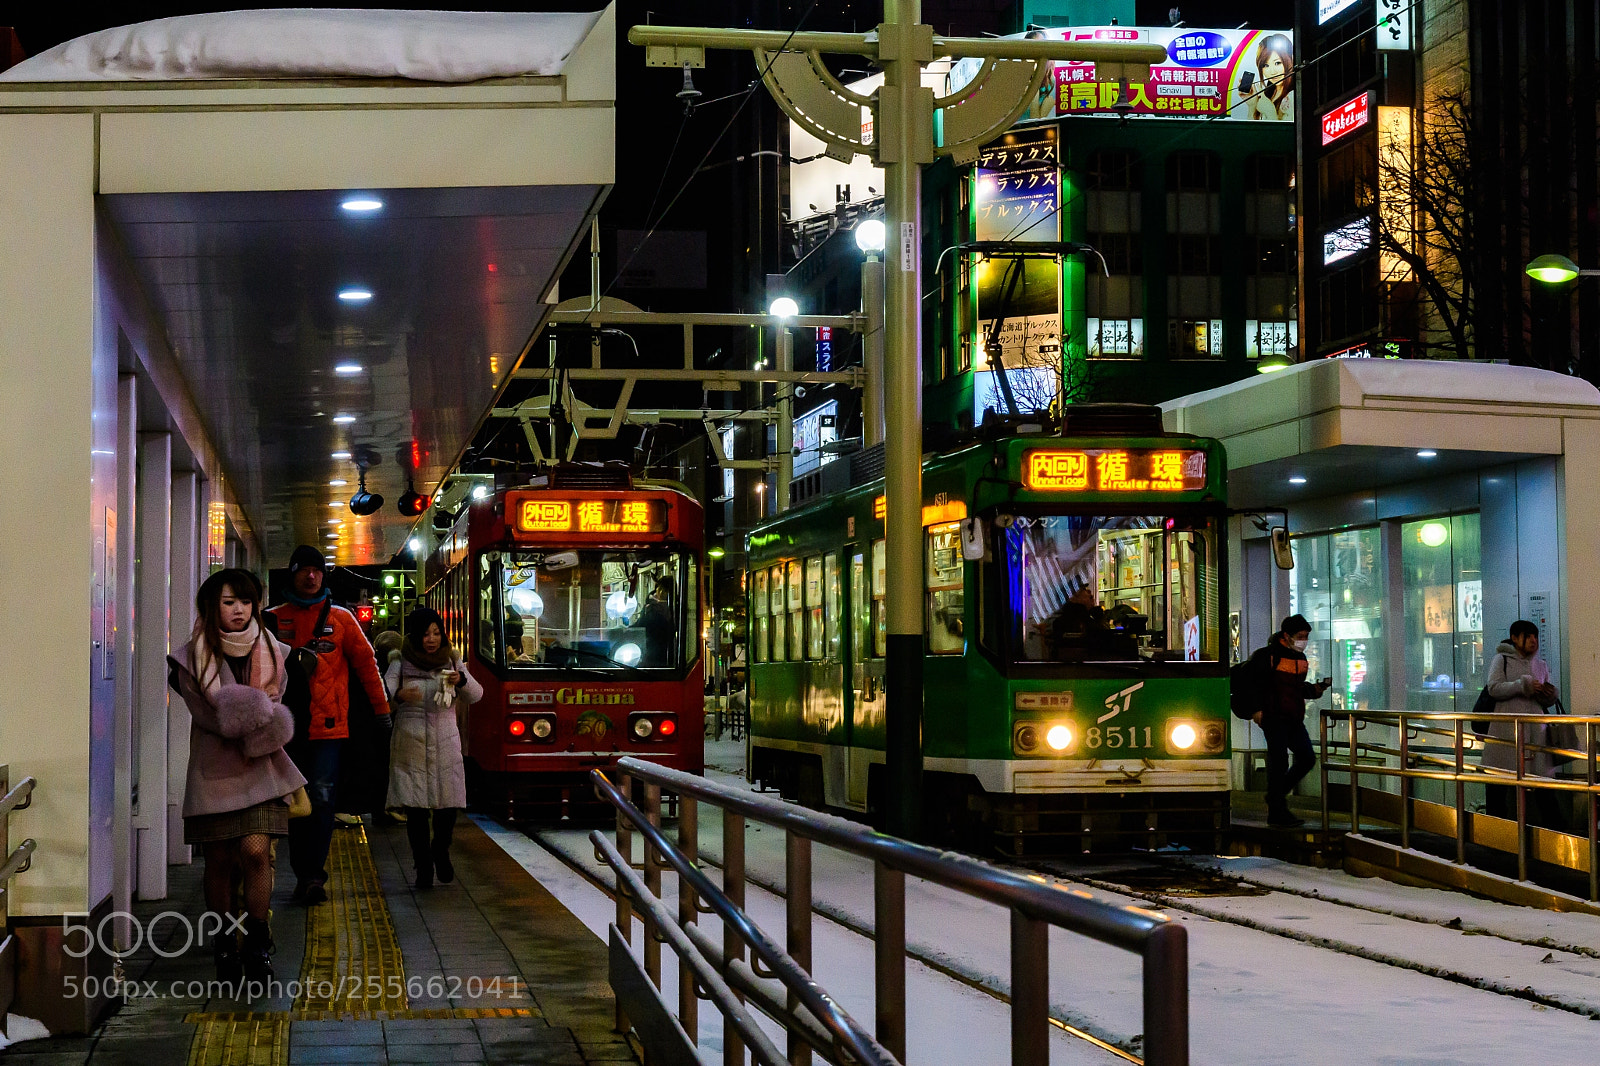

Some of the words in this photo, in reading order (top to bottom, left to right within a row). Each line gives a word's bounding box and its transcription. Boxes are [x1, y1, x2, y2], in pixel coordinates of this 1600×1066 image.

[1174, 35, 1206, 48] 全国の
[1059, 83, 1069, 110] 女性の
[1070, 81, 1154, 111] 高収入
[1159, 87, 1182, 95] 15navi
[1156, 98, 1222, 111] お仕事探し
[980, 146, 1055, 167] デラックス
[981, 172, 1055, 194] ラックス
[1094, 329, 1137, 345] 桜坂
[1252, 331, 1298, 348] 桜坂
[1033, 456, 1084, 476] 内回り
[1100, 480, 1149, 490] Circular
[1151, 480, 1183, 490] route
[525, 504, 569, 521] 外回り
[581, 523, 621, 532] Circular
[622, 523, 648, 532] route
[556, 687, 636, 705] Ghana
[1097, 680, 1144, 725] ST
[1085, 726, 1154, 748] 8511
